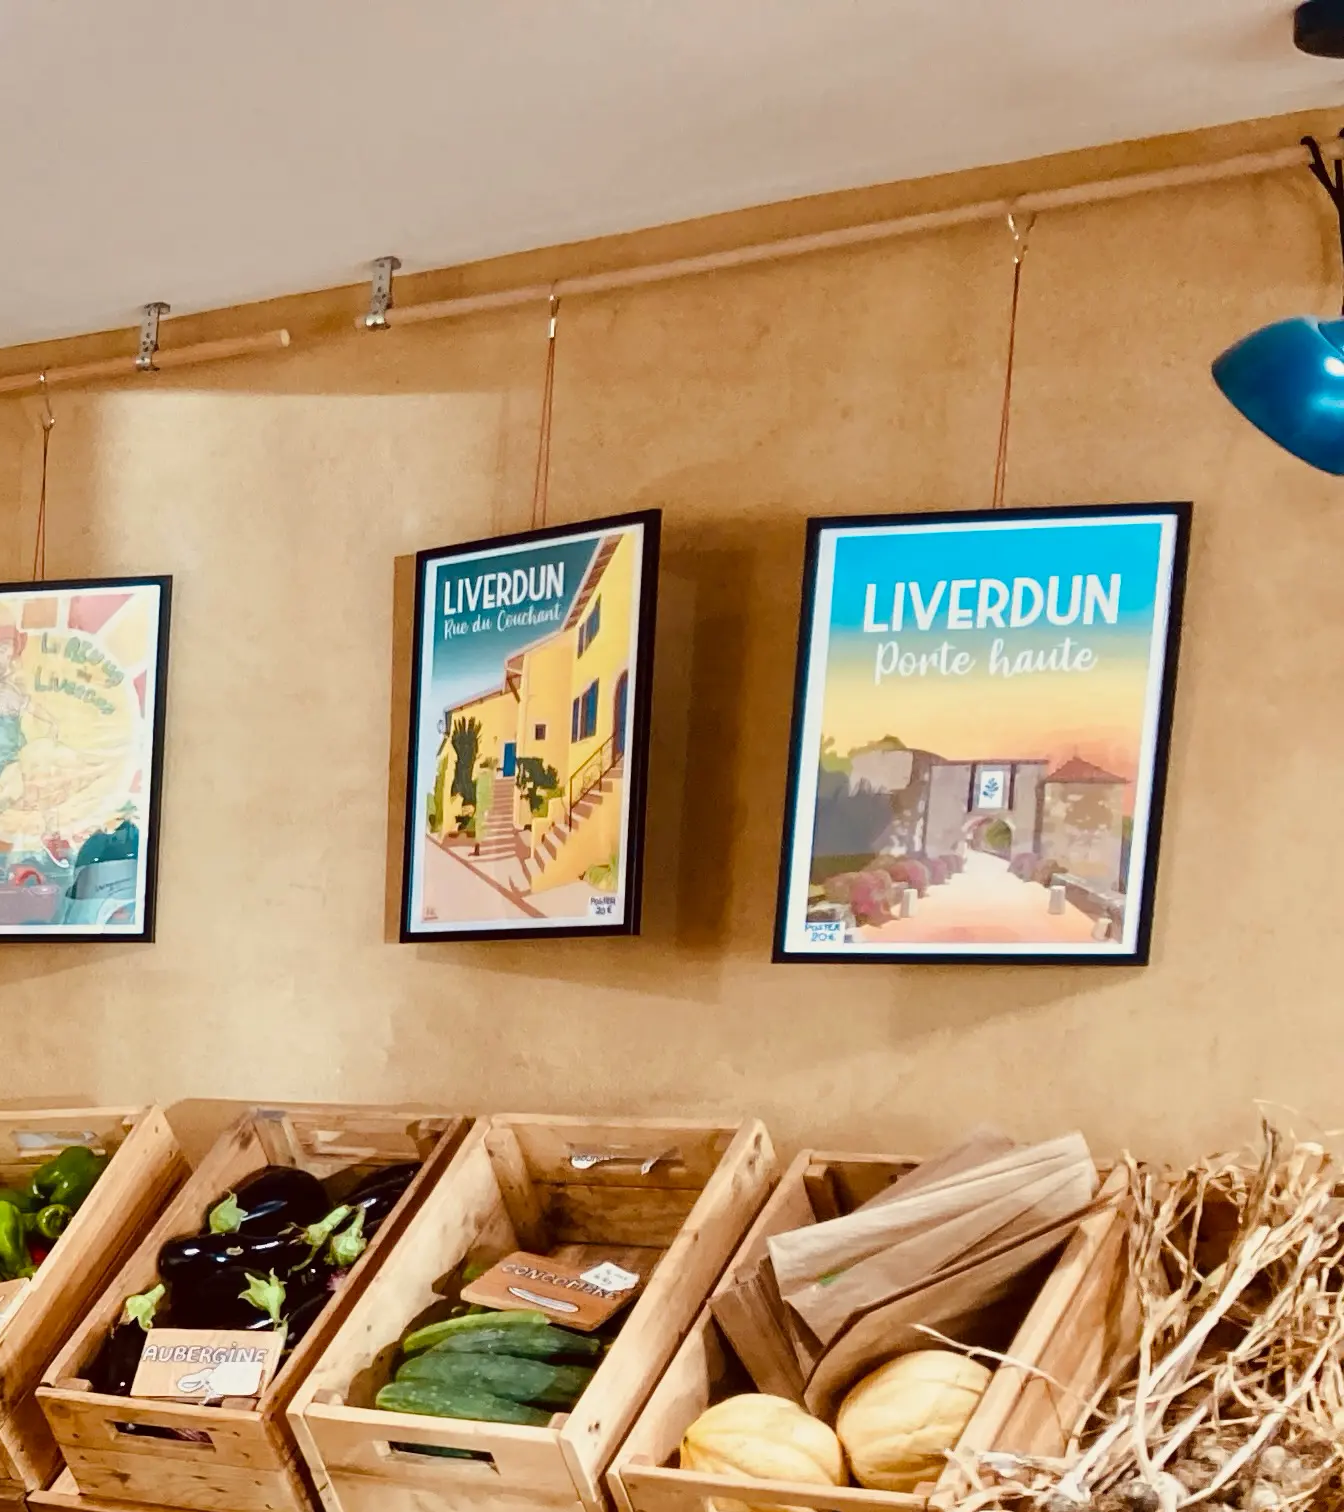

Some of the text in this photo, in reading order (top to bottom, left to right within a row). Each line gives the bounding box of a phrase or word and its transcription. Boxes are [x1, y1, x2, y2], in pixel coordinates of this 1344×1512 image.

[444, 561, 565, 615] LIVERDUN
[864, 573, 1121, 633] LIVERDUN
[444, 603, 562, 640] Rue du Couchant
[875, 637, 1099, 686] Porte haute
